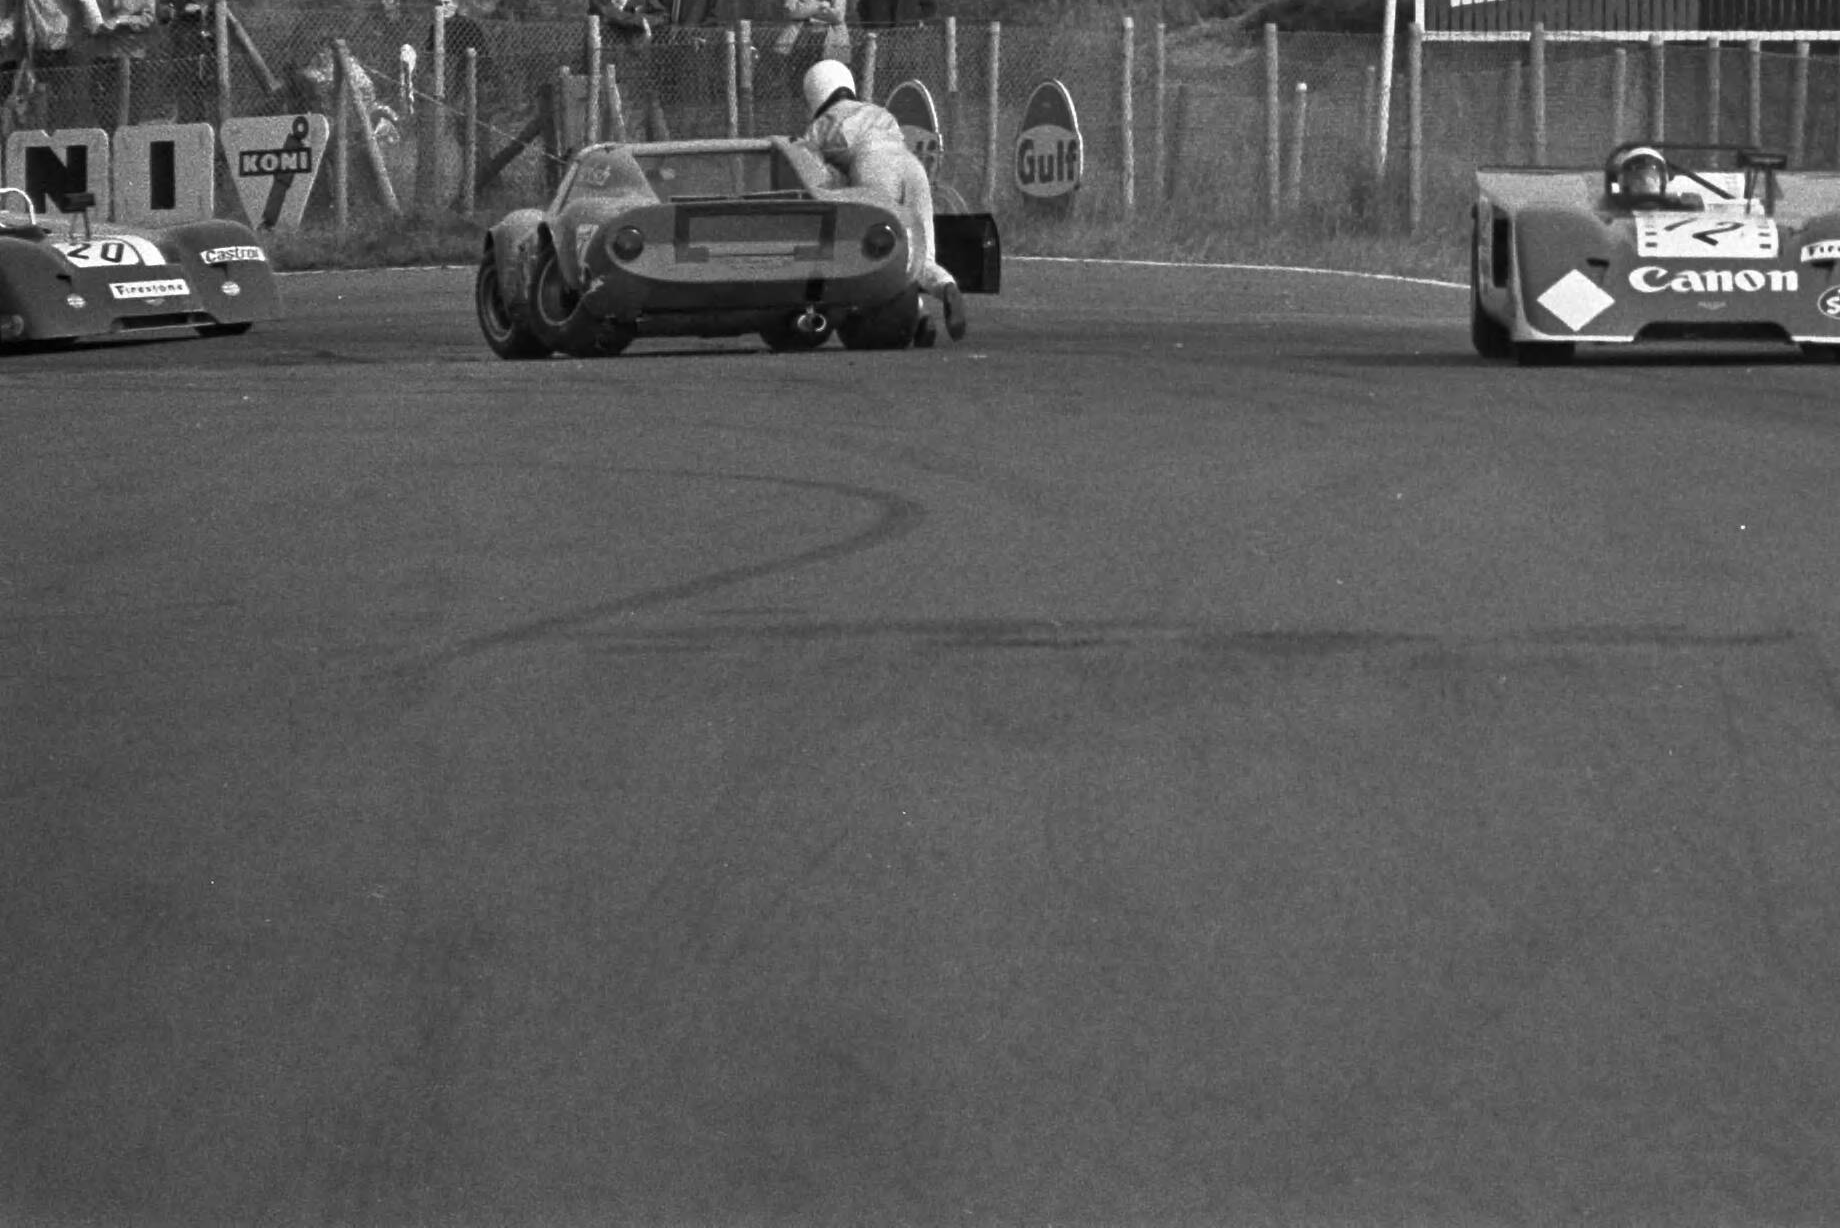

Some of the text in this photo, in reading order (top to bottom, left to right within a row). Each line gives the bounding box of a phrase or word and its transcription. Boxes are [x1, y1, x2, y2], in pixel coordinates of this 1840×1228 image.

[242, 150, 309, 172] KONI
[1018, 138, 1077, 185] Gulf
[66, 241, 125, 263] 20
[114, 283, 184, 297] Firestone
[1628, 266, 1799, 293] Canon
